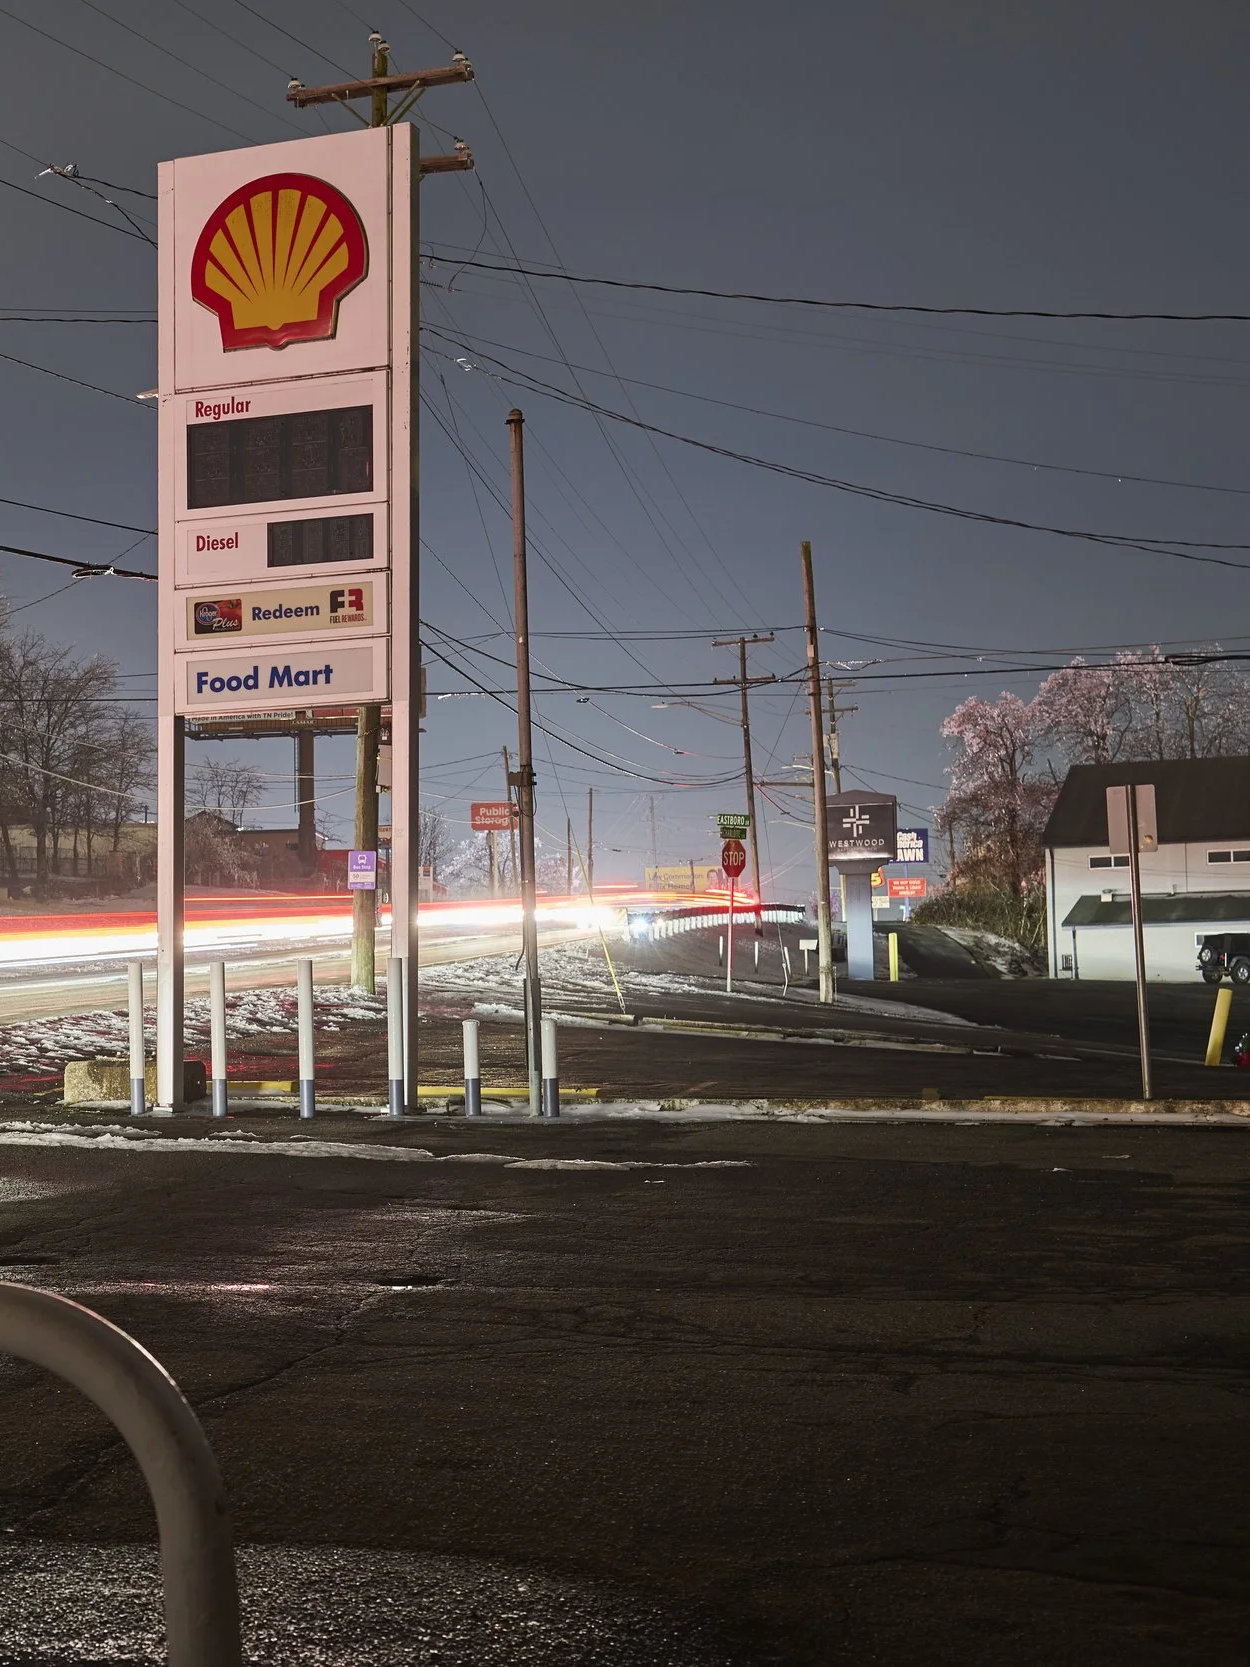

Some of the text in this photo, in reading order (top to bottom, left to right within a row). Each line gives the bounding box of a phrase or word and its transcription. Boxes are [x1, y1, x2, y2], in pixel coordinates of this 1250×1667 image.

[195, 396, 251, 420] Regular
[196, 532, 239, 552] Diesel
[198, 606, 218, 618] Kroger
[251, 604, 320, 621] Redeem
[329, 613, 365, 624] FUEL REWARDS
[212, 617, 239, 631] Plus
[196, 664, 333, 694] Food Mart
[247, 711, 263, 719] with
[479, 807, 510, 816] Public
[717, 815, 745, 825] EASTBORO
[829, 838, 885, 848] WESTWOOD
[723, 851, 745, 866] STOP
[895, 848, 924, 862] AWN
